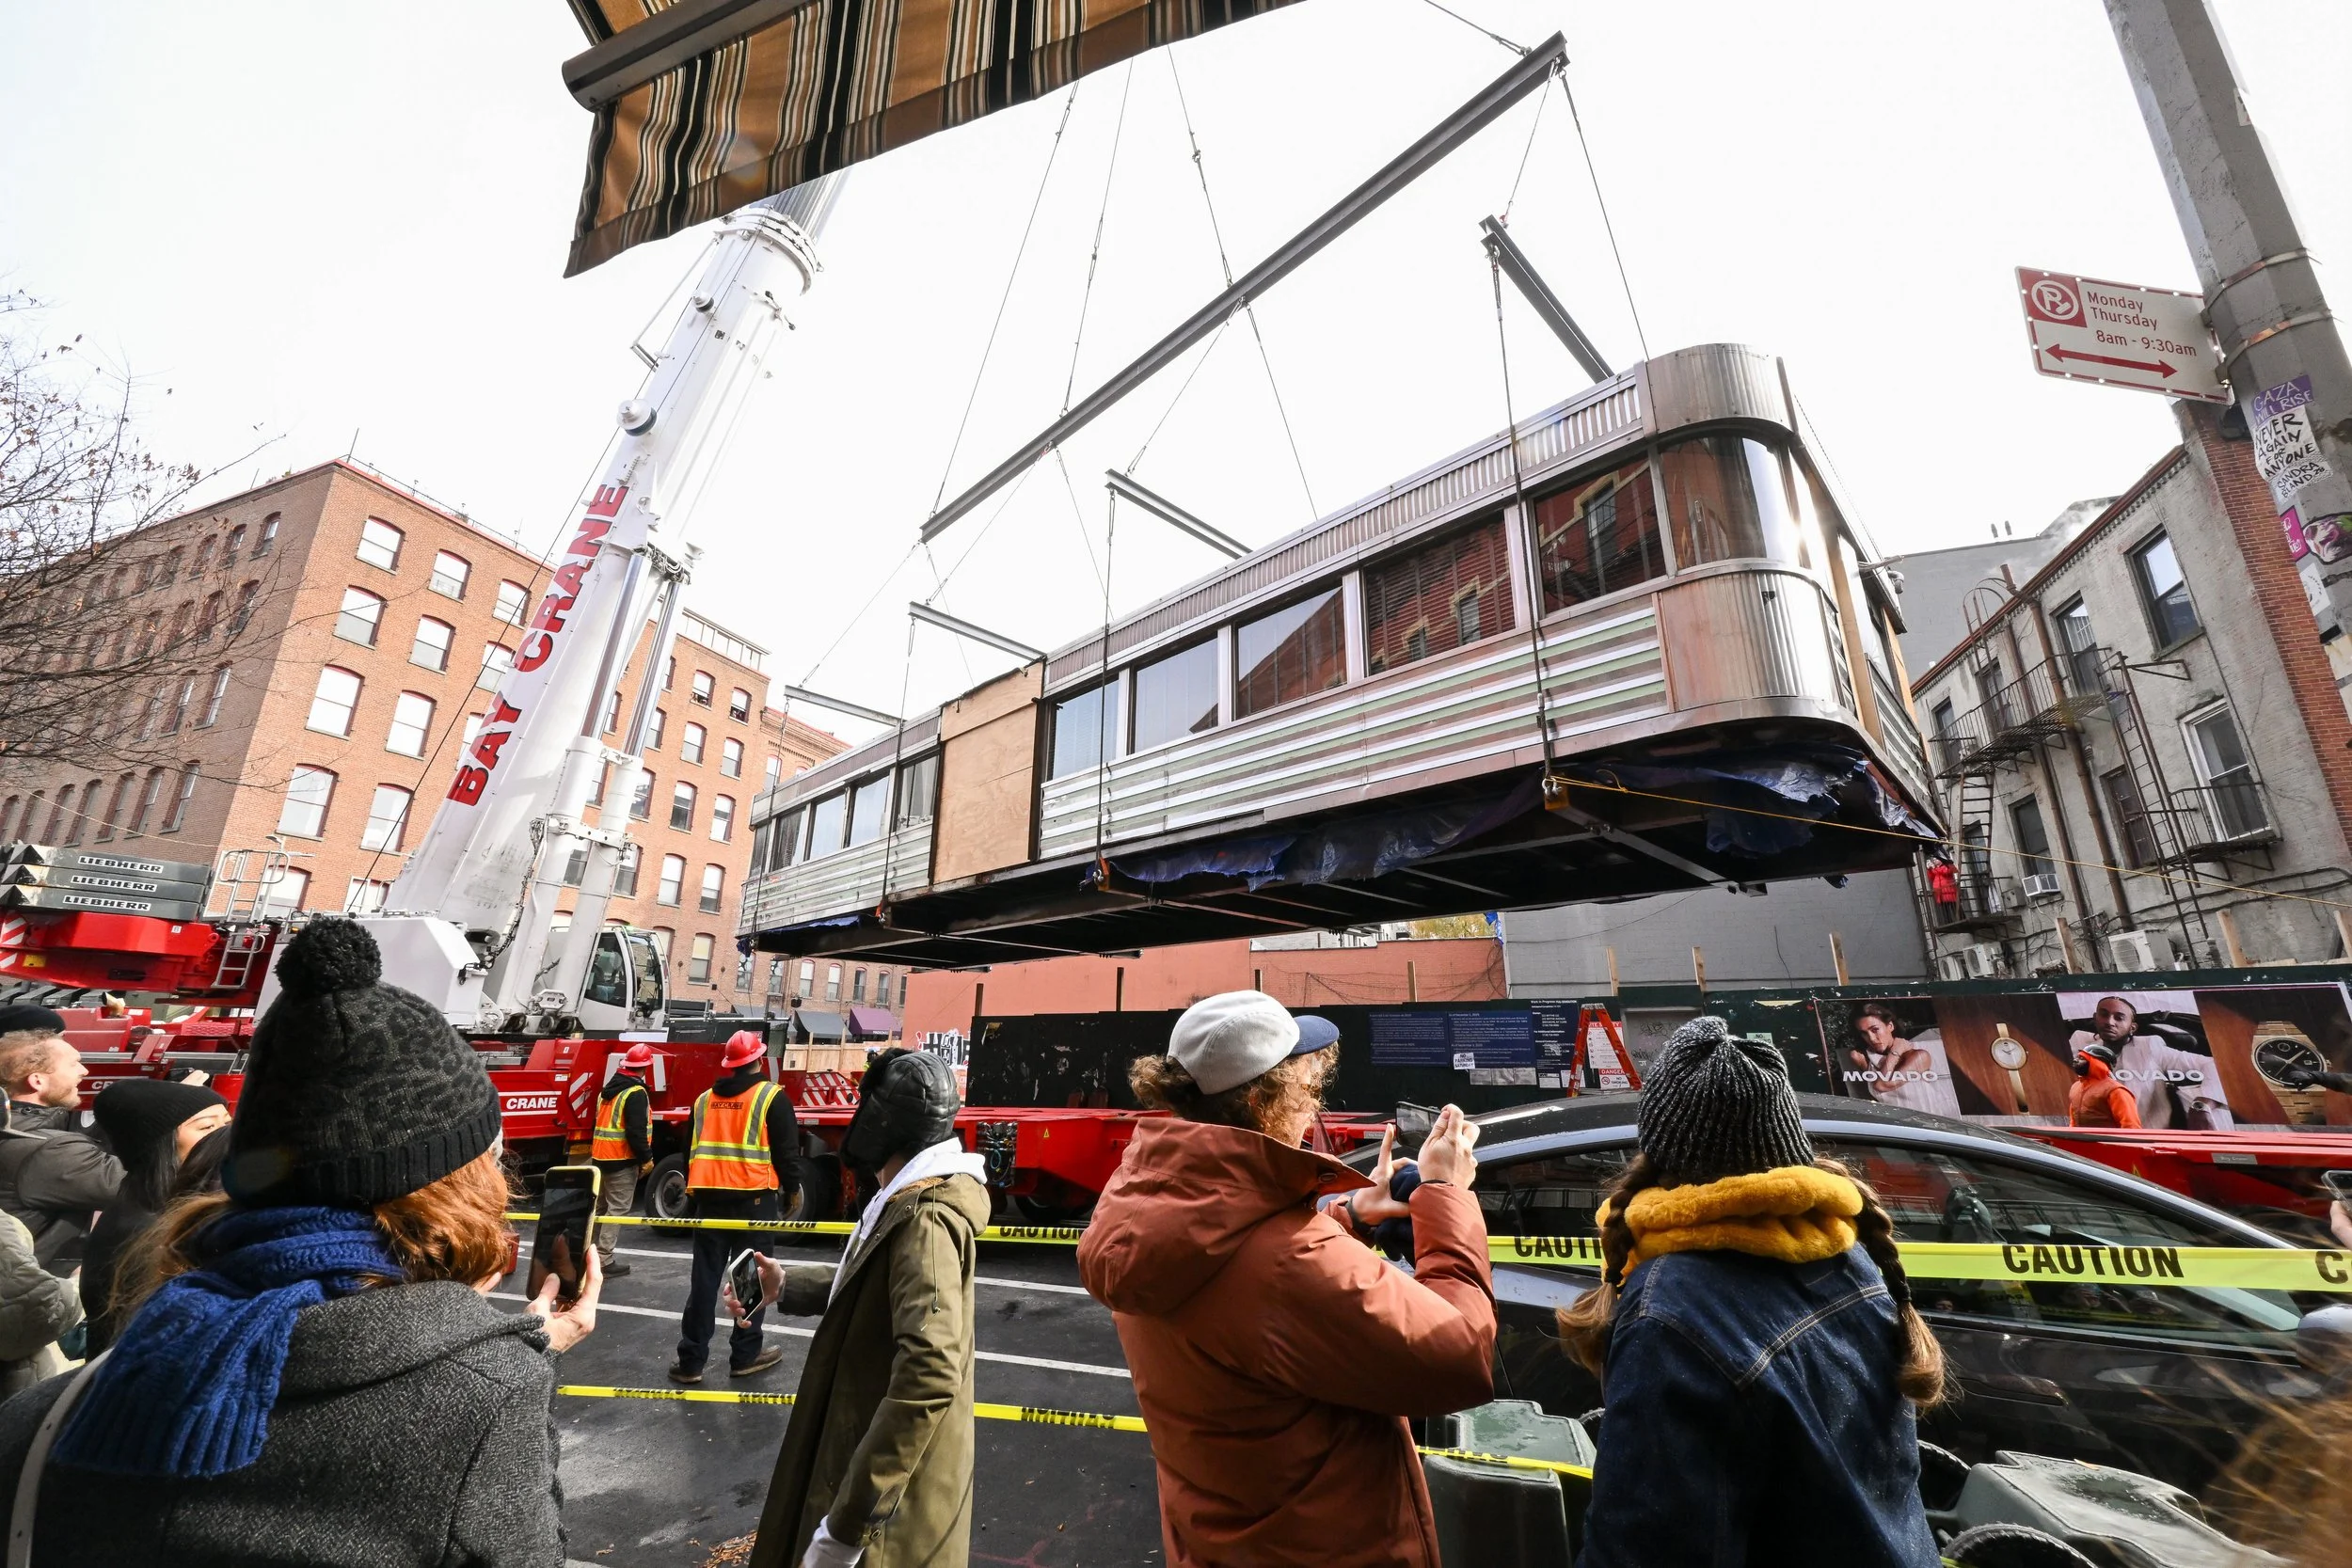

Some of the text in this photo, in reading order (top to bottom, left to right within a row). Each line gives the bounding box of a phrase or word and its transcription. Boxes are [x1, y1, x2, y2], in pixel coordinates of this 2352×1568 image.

[2086, 291, 2144, 313] Monday
[2090, 307, 2157, 330] Thursday
[2096, 329, 2127, 346] 8am
[2140, 337, 2197, 356] 9:30am
[2253, 381, 2300, 412] GAZA
[2255, 389, 2313, 424] WILL RISE
[2255, 413, 2303, 447] NEVER
[2258, 430, 2301, 460] AGAIN
[2265, 447, 2285, 465] FOR
[2264, 442, 2315, 478] ANYONE
[2277, 462, 2320, 489] SANDRA
[2281, 473, 2312, 498] BLAND
[447, 483, 629, 807] BAY CRANE
[79, 857, 162, 872] LIEBHERR
[72, 876, 155, 892] LIEBHERR
[65, 896, 149, 911] LIEBHERR
[1843, 1070, 1938, 1082] MOVADO
[2109, 1069, 2204, 1082] OVADO
[506, 1097, 558, 1110] CRANE
[1514, 1237, 1602, 1259] CAUTI
[2002, 1244, 2185, 1278] CAUTION
[2315, 1250, 2352, 1284] C
